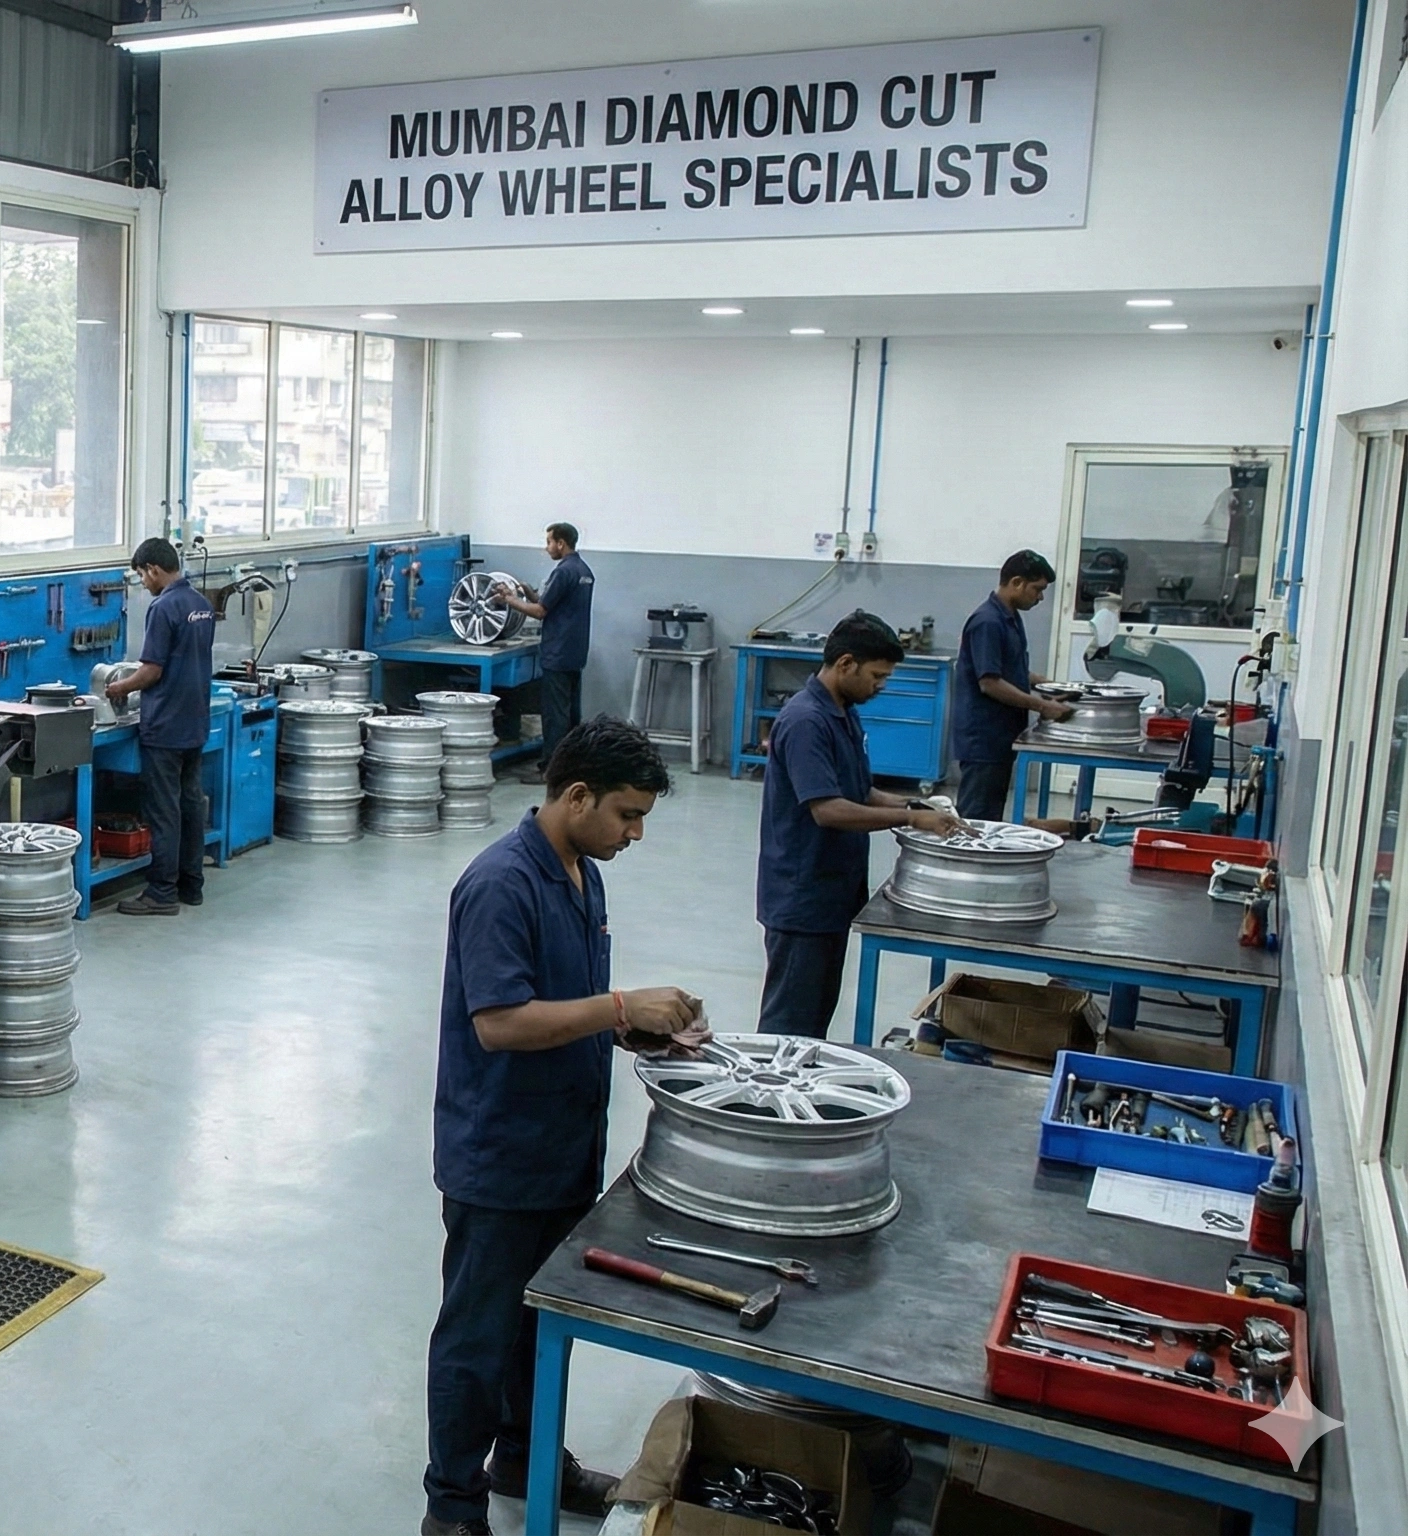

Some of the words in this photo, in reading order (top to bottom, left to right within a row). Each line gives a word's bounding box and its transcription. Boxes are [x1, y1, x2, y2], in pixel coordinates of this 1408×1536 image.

[389, 99, 586, 159] MUMBAI
[605, 80, 859, 146] DIAMOND
[880, 69, 997, 129] CUT
[339, 171, 484, 224] ALLOY
[498, 162, 667, 216] WHEEL
[683, 140, 1048, 209] SPECIALISTS
